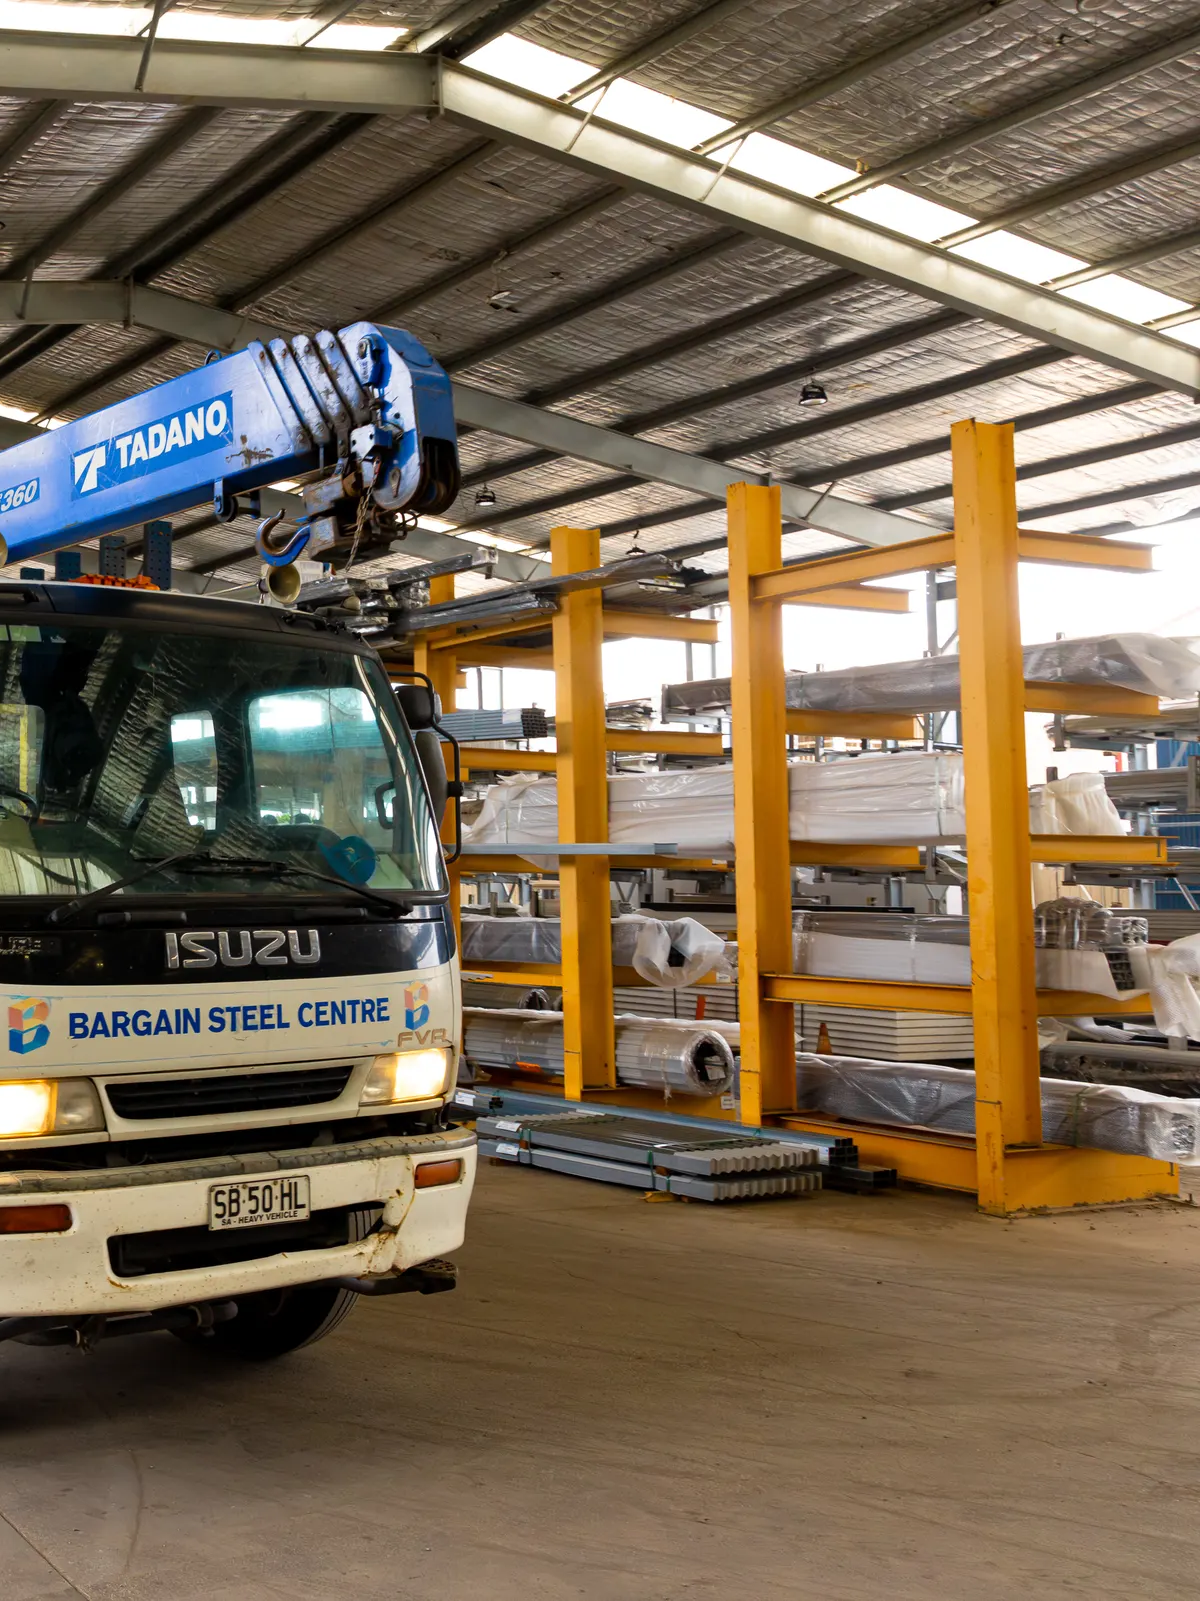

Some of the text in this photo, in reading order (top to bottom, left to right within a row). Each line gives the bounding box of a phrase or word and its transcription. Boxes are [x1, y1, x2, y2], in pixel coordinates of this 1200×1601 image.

[115, 400, 228, 469] TADANO
[165, 930, 321, 969] ISUZU
[68, 997, 390, 1040] BARGAIN STEEL CENTRE
[238, 1214, 264, 1224] HEAVY
[266, 1210, 299, 1221] VEHICLE
